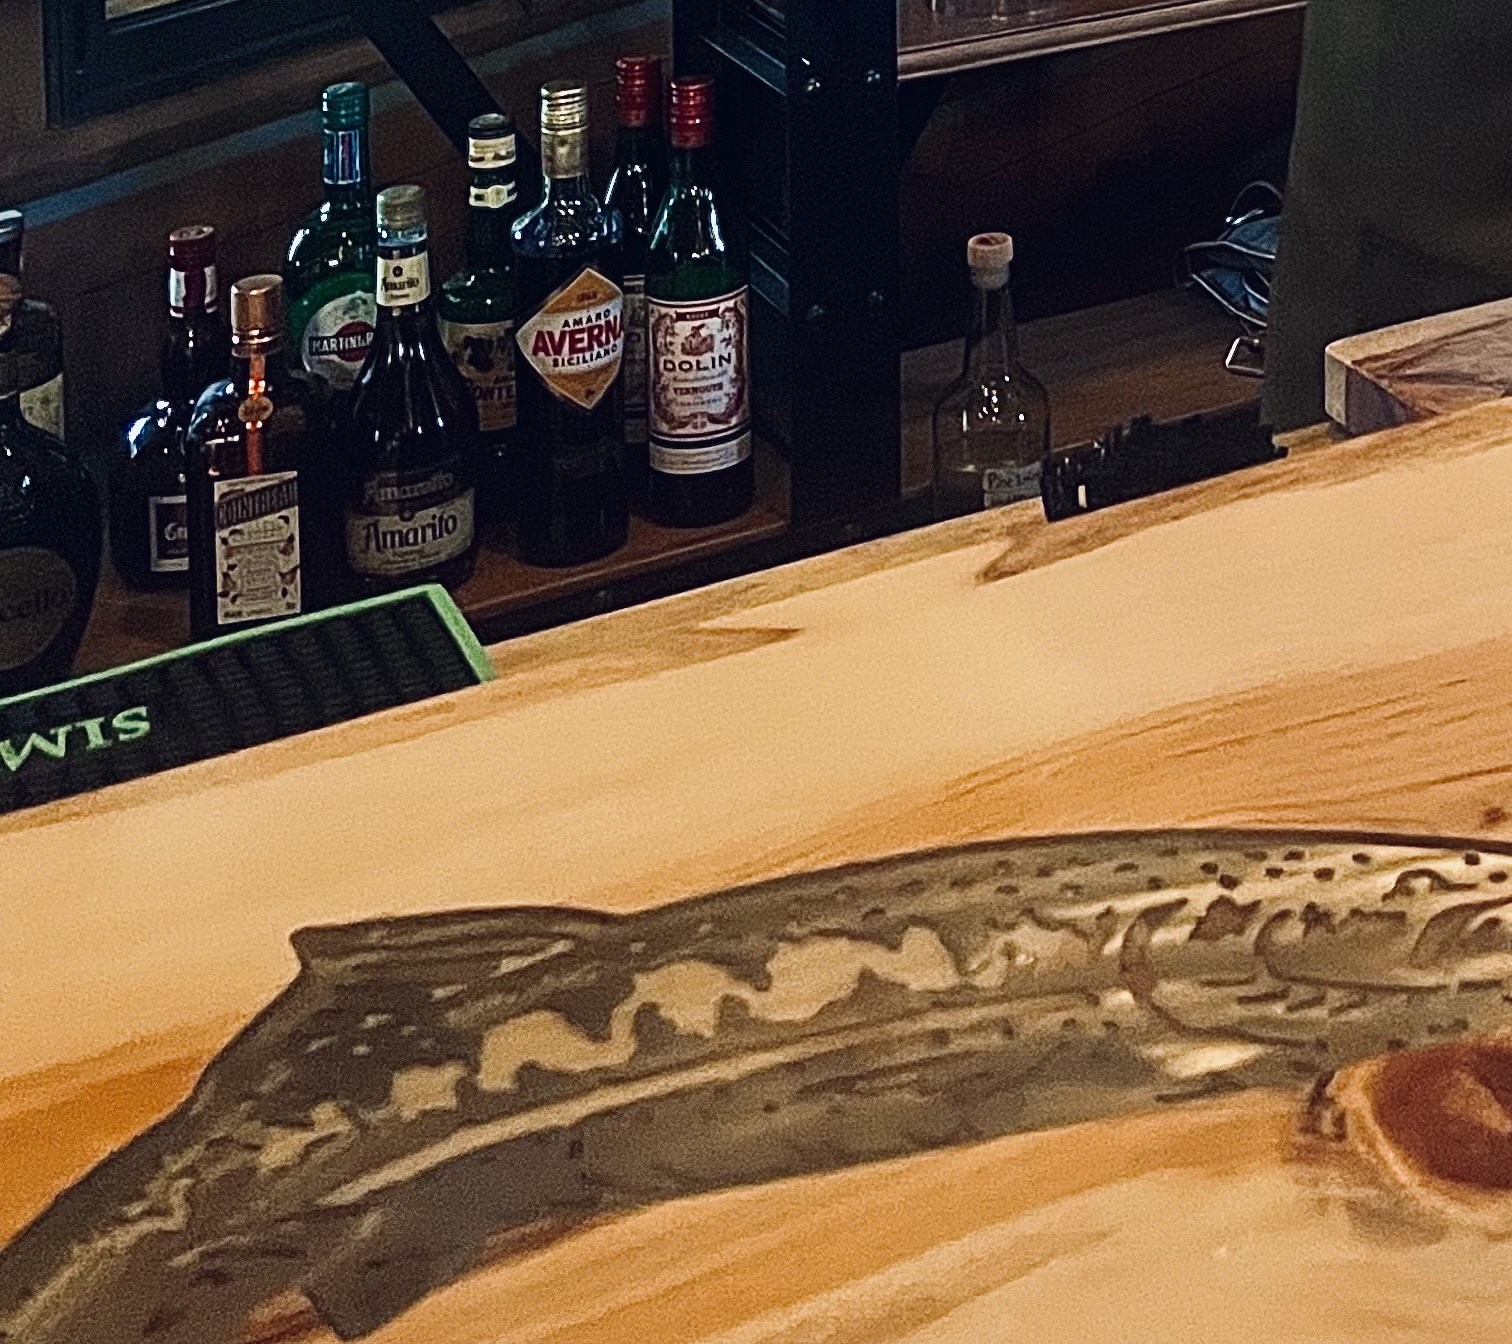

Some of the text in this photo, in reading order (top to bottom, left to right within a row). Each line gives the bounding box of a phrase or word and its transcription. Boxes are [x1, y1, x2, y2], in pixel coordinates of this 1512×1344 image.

[561, 308, 612, 329] AMARO
[551, 342, 619, 369] SICILIANO
[663, 352, 733, 373] DOLIN
